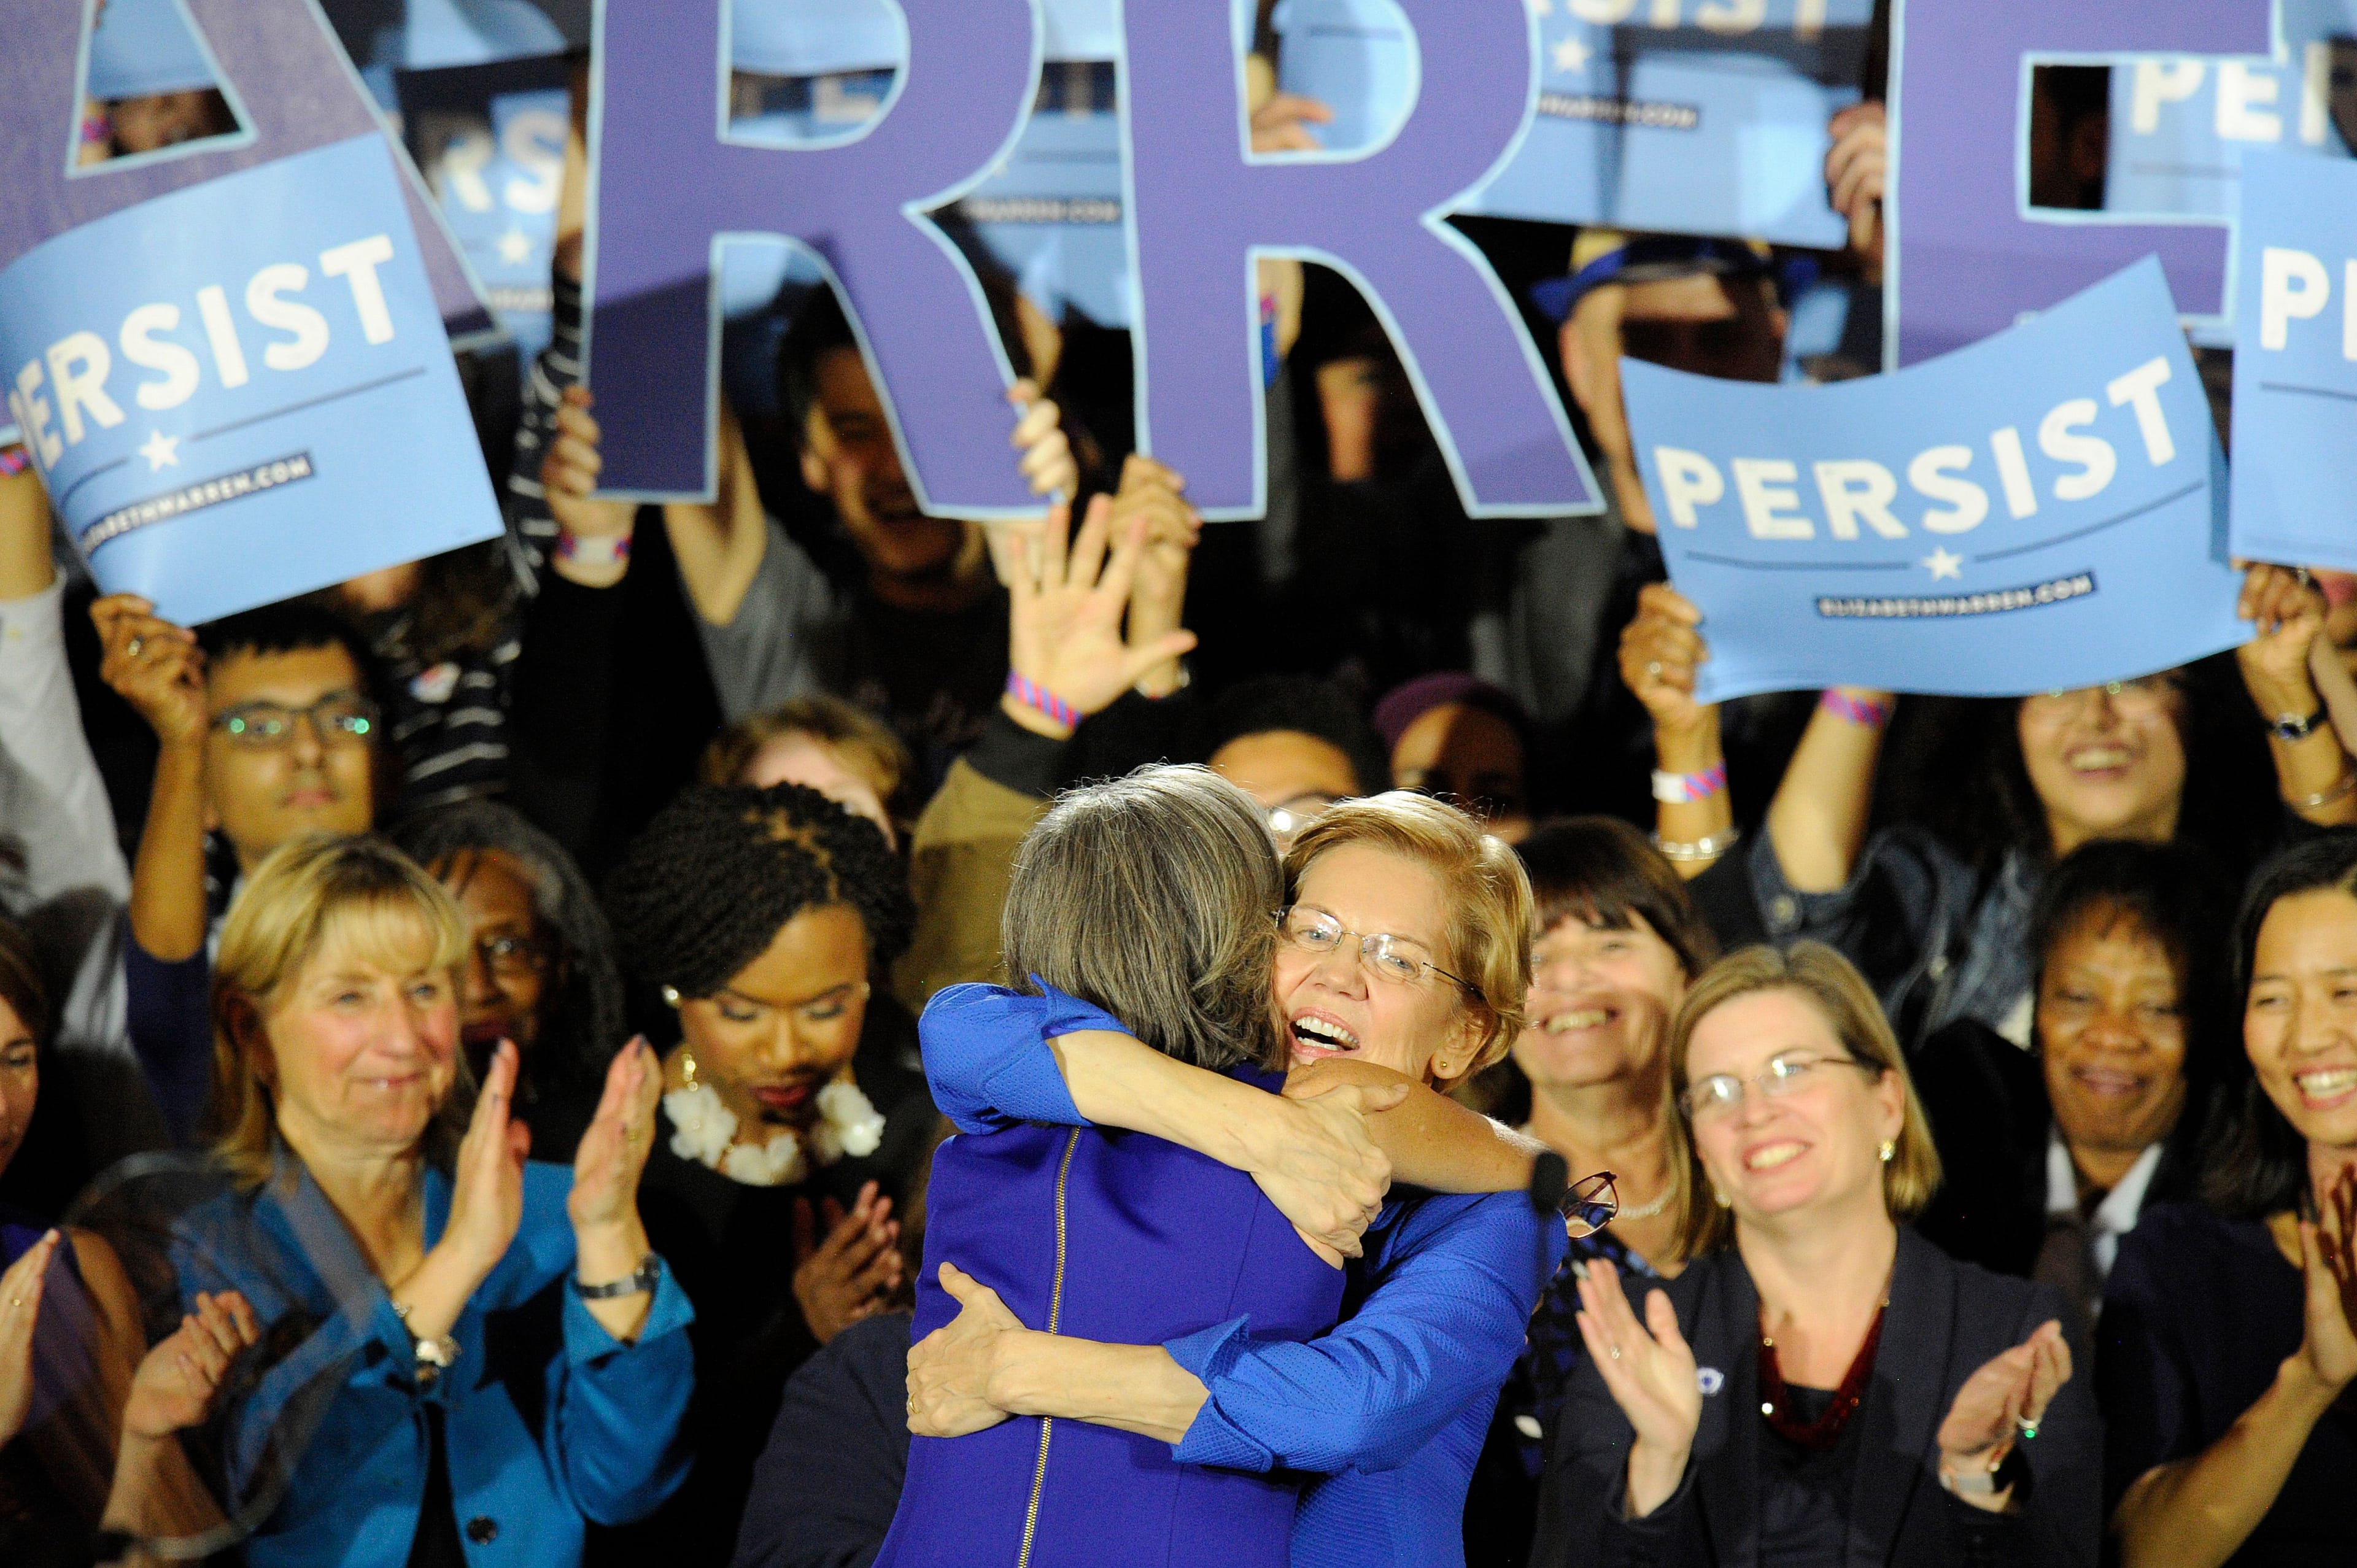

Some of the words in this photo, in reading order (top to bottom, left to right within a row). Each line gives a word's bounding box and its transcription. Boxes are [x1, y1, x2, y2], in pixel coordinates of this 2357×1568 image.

[9, 233, 395, 471] ERSIST
[2260, 247, 2357, 361] P
[1654, 355, 2177, 540] PERSIST
[1818, 573, 2093, 617] ELIZABETHWARREN.COM
